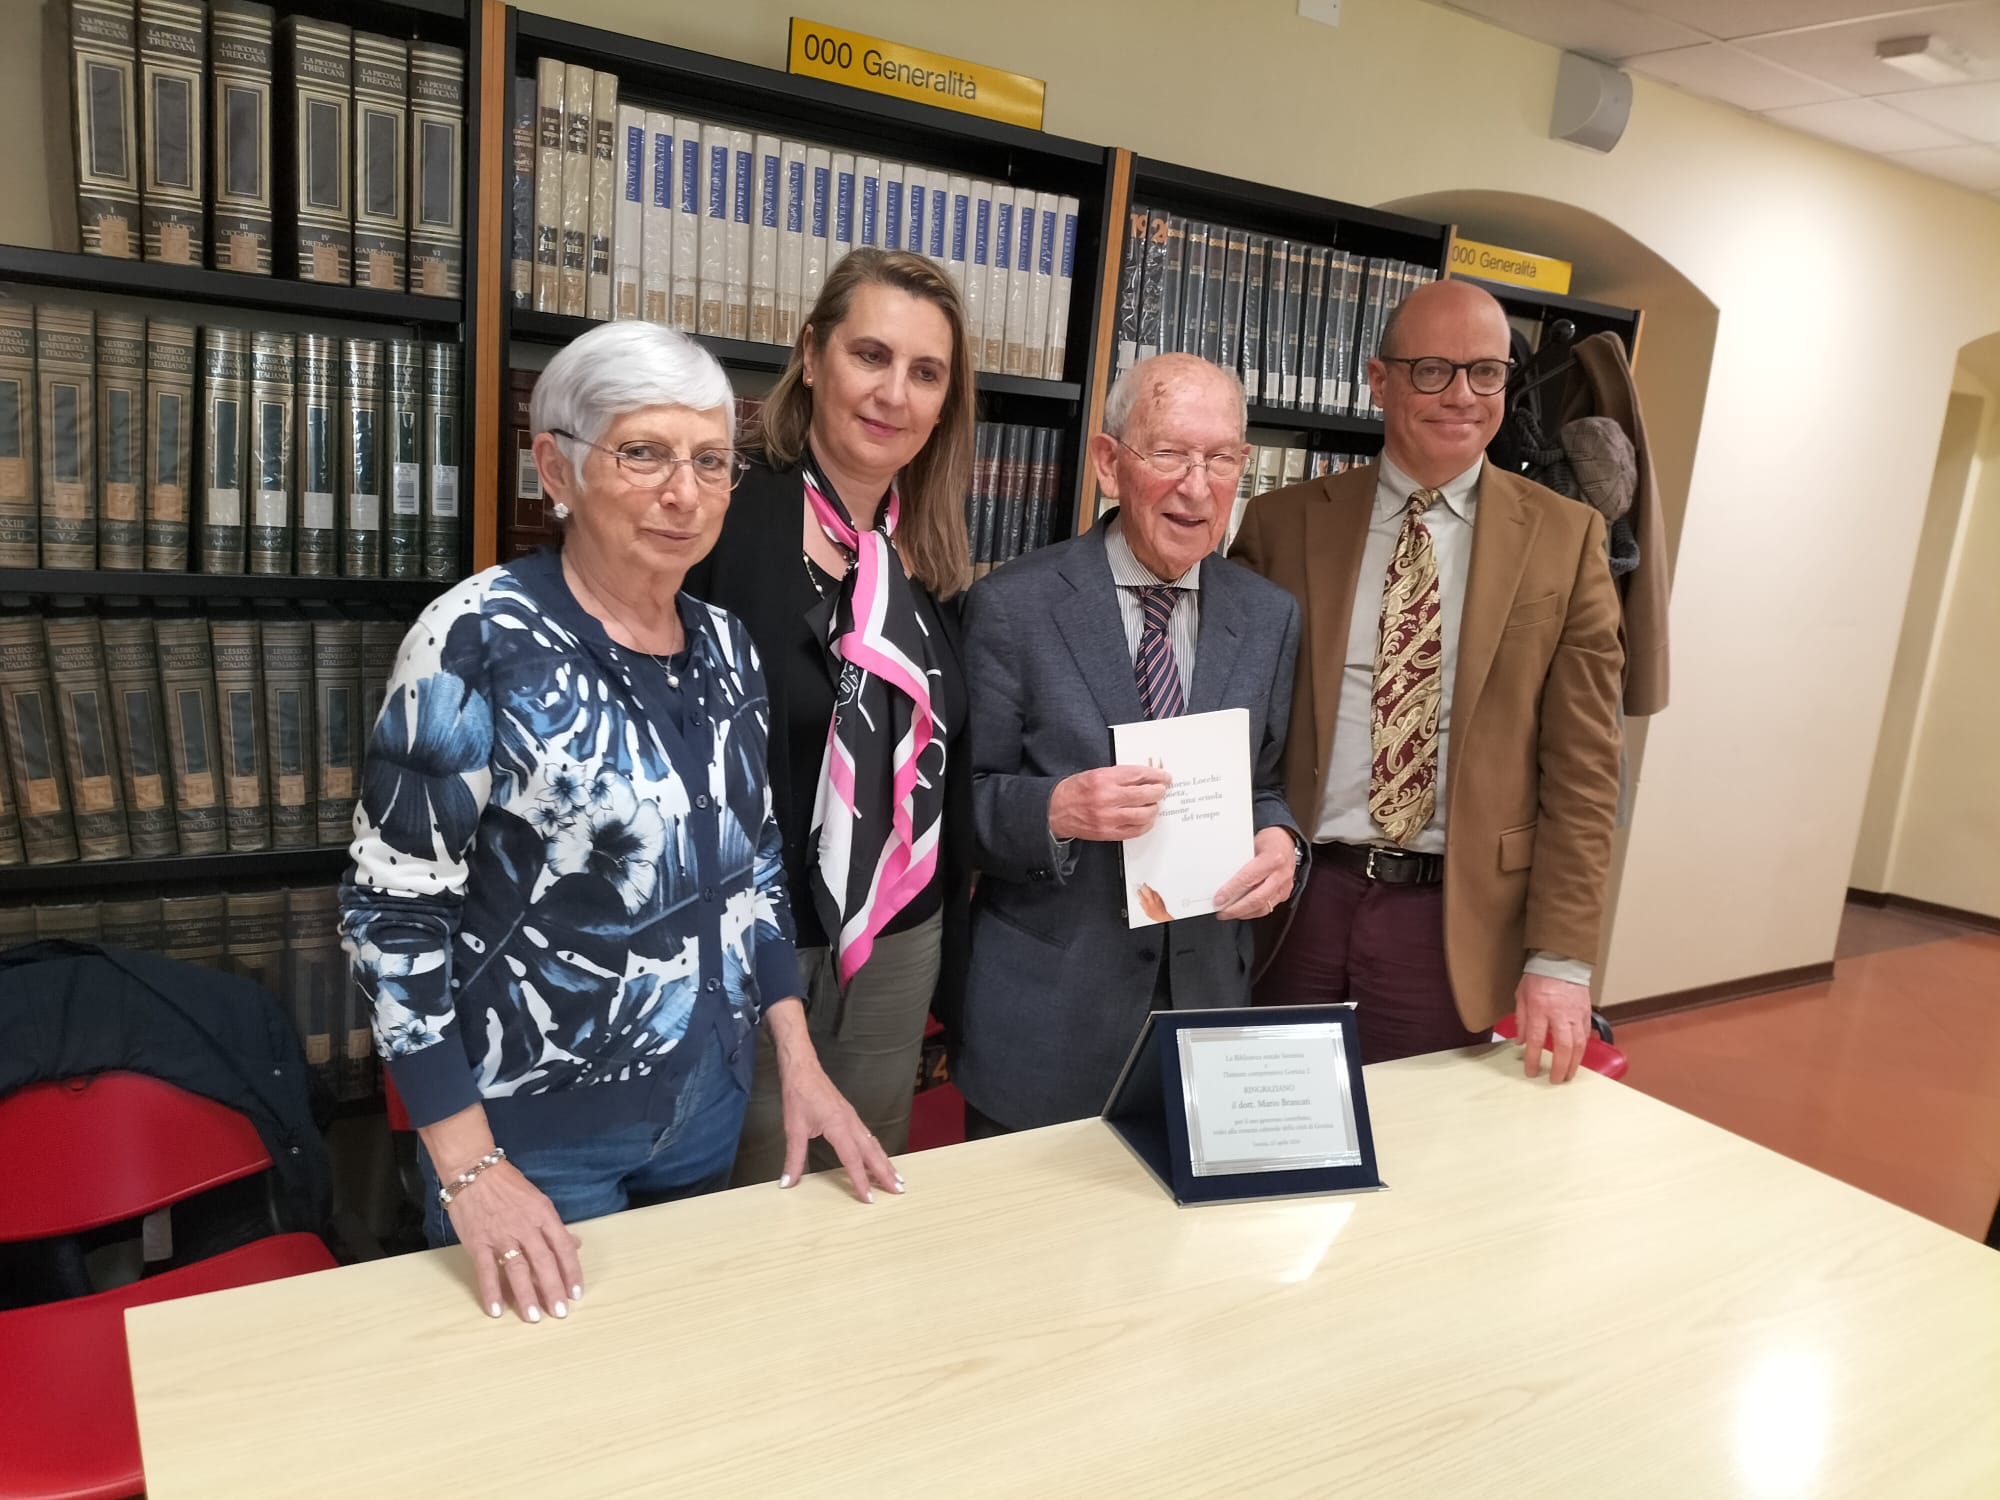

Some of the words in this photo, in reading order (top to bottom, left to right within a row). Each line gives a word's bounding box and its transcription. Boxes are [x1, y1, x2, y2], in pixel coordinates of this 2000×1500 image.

[80, 24, 128, 40] TRECCANI
[147, 36, 196, 52] TRECCANI
[220, 49, 266, 64] TRECCANI
[302, 62, 344, 78] TRECCANI
[804, 34, 852, 68] 000
[863, 50, 977, 100] Generalità
[360, 74, 402, 89] TRECCANI
[417, 86, 459, 100] TRECCANI
[628, 129, 638, 200] UNIVERSALIS
[655, 136, 665, 206] UNIVERSALIS
[814, 169, 824, 236] UNIVERSALIS
[838, 174, 848, 240] UNIVERSALIS
[240, 222, 248, 230] III
[1130, 213, 1147, 238] 19
[1151, 218, 1168, 244] 2
[1452, 246, 1476, 265] 000
[1480, 252, 1537, 278] Generalità
[48, 334, 81, 344] LESSICO
[104, 340, 134, 350] LESSICO
[40, 341, 88, 352] UNIVERSALE
[156, 345, 185, 355] LESSICO
[46, 348, 85, 360] ITALIANO
[149, 352, 192, 364] UNIVERSALE
[154, 360, 188, 370] ITALIANO
[58, 532, 80, 542] V-Z
[1192, 774, 1222, 785] Locchi:
[1196, 811, 1221, 821] tempo
[1244, 1084, 1295, 1094] RINGRAZIANO
[1238, 1100, 1256, 1109] dott.
[1258, 1099, 1280, 1108] Mario
